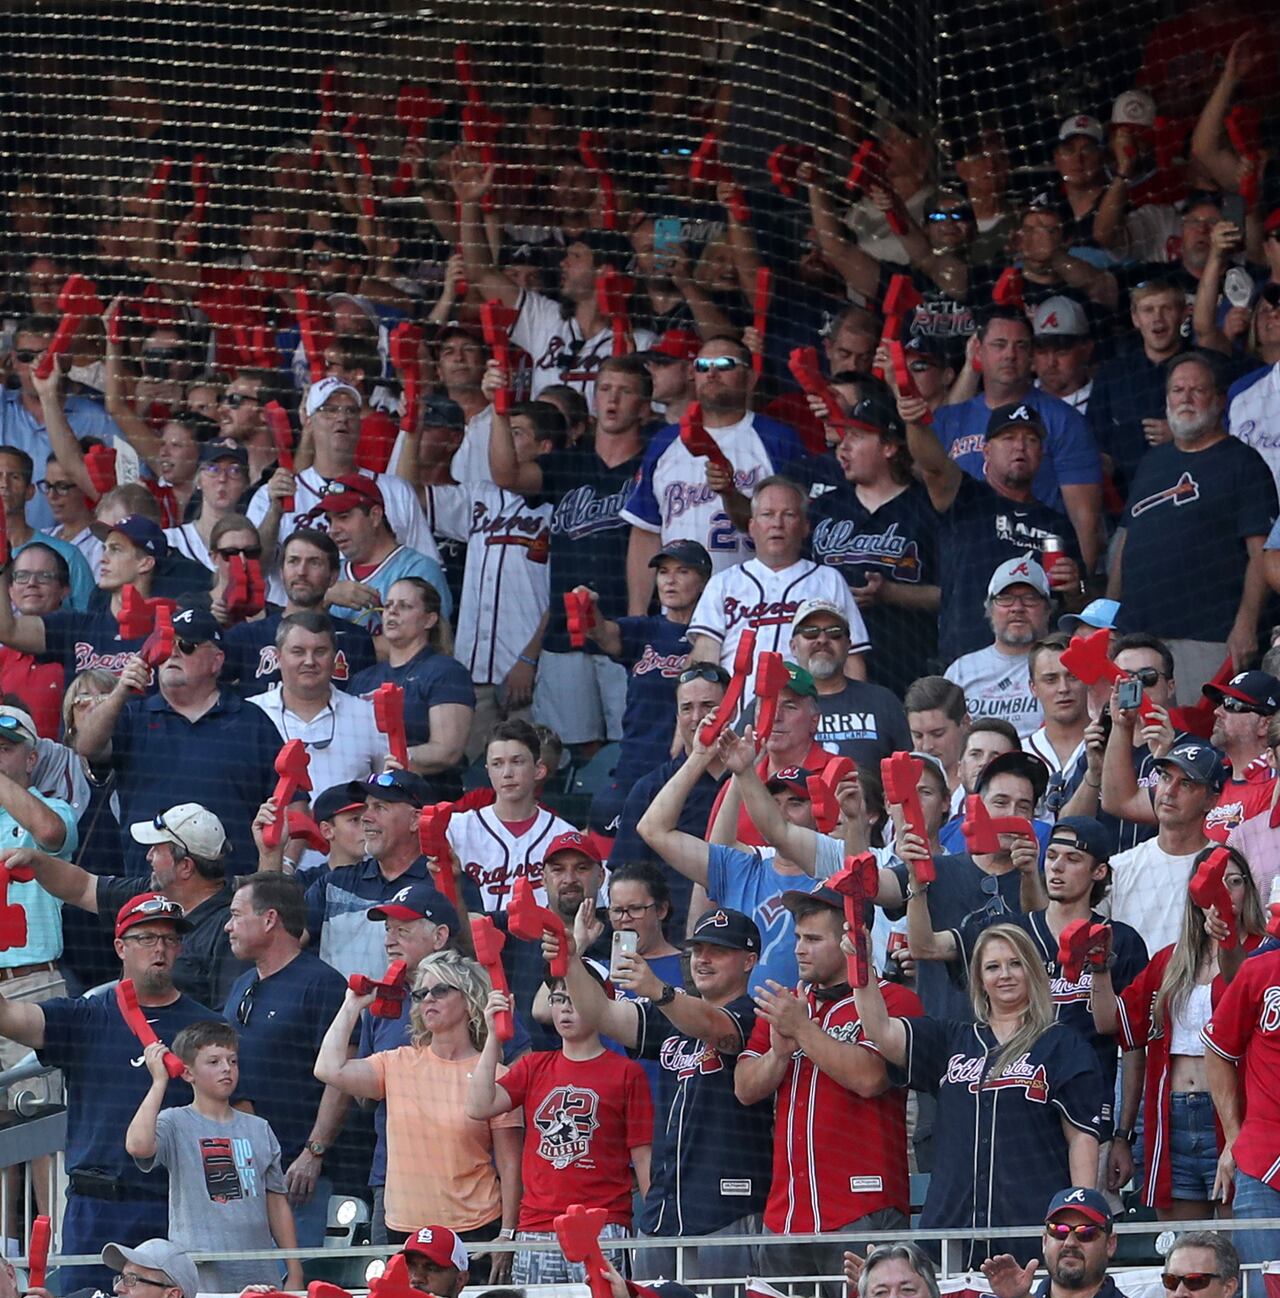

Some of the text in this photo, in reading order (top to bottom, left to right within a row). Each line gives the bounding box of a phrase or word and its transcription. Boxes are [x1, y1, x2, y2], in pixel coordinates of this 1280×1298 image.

[1009, 405, 1030, 421] A
[551, 489, 623, 532] Atlan
[812, 519, 905, 558] Atlanta
[1009, 562, 1030, 577] A
[391, 886, 412, 902] A
[536, 1089, 596, 1122] 42
[542, 1141, 586, 1157] CLASSIC
[1064, 1189, 1086, 1202] A
